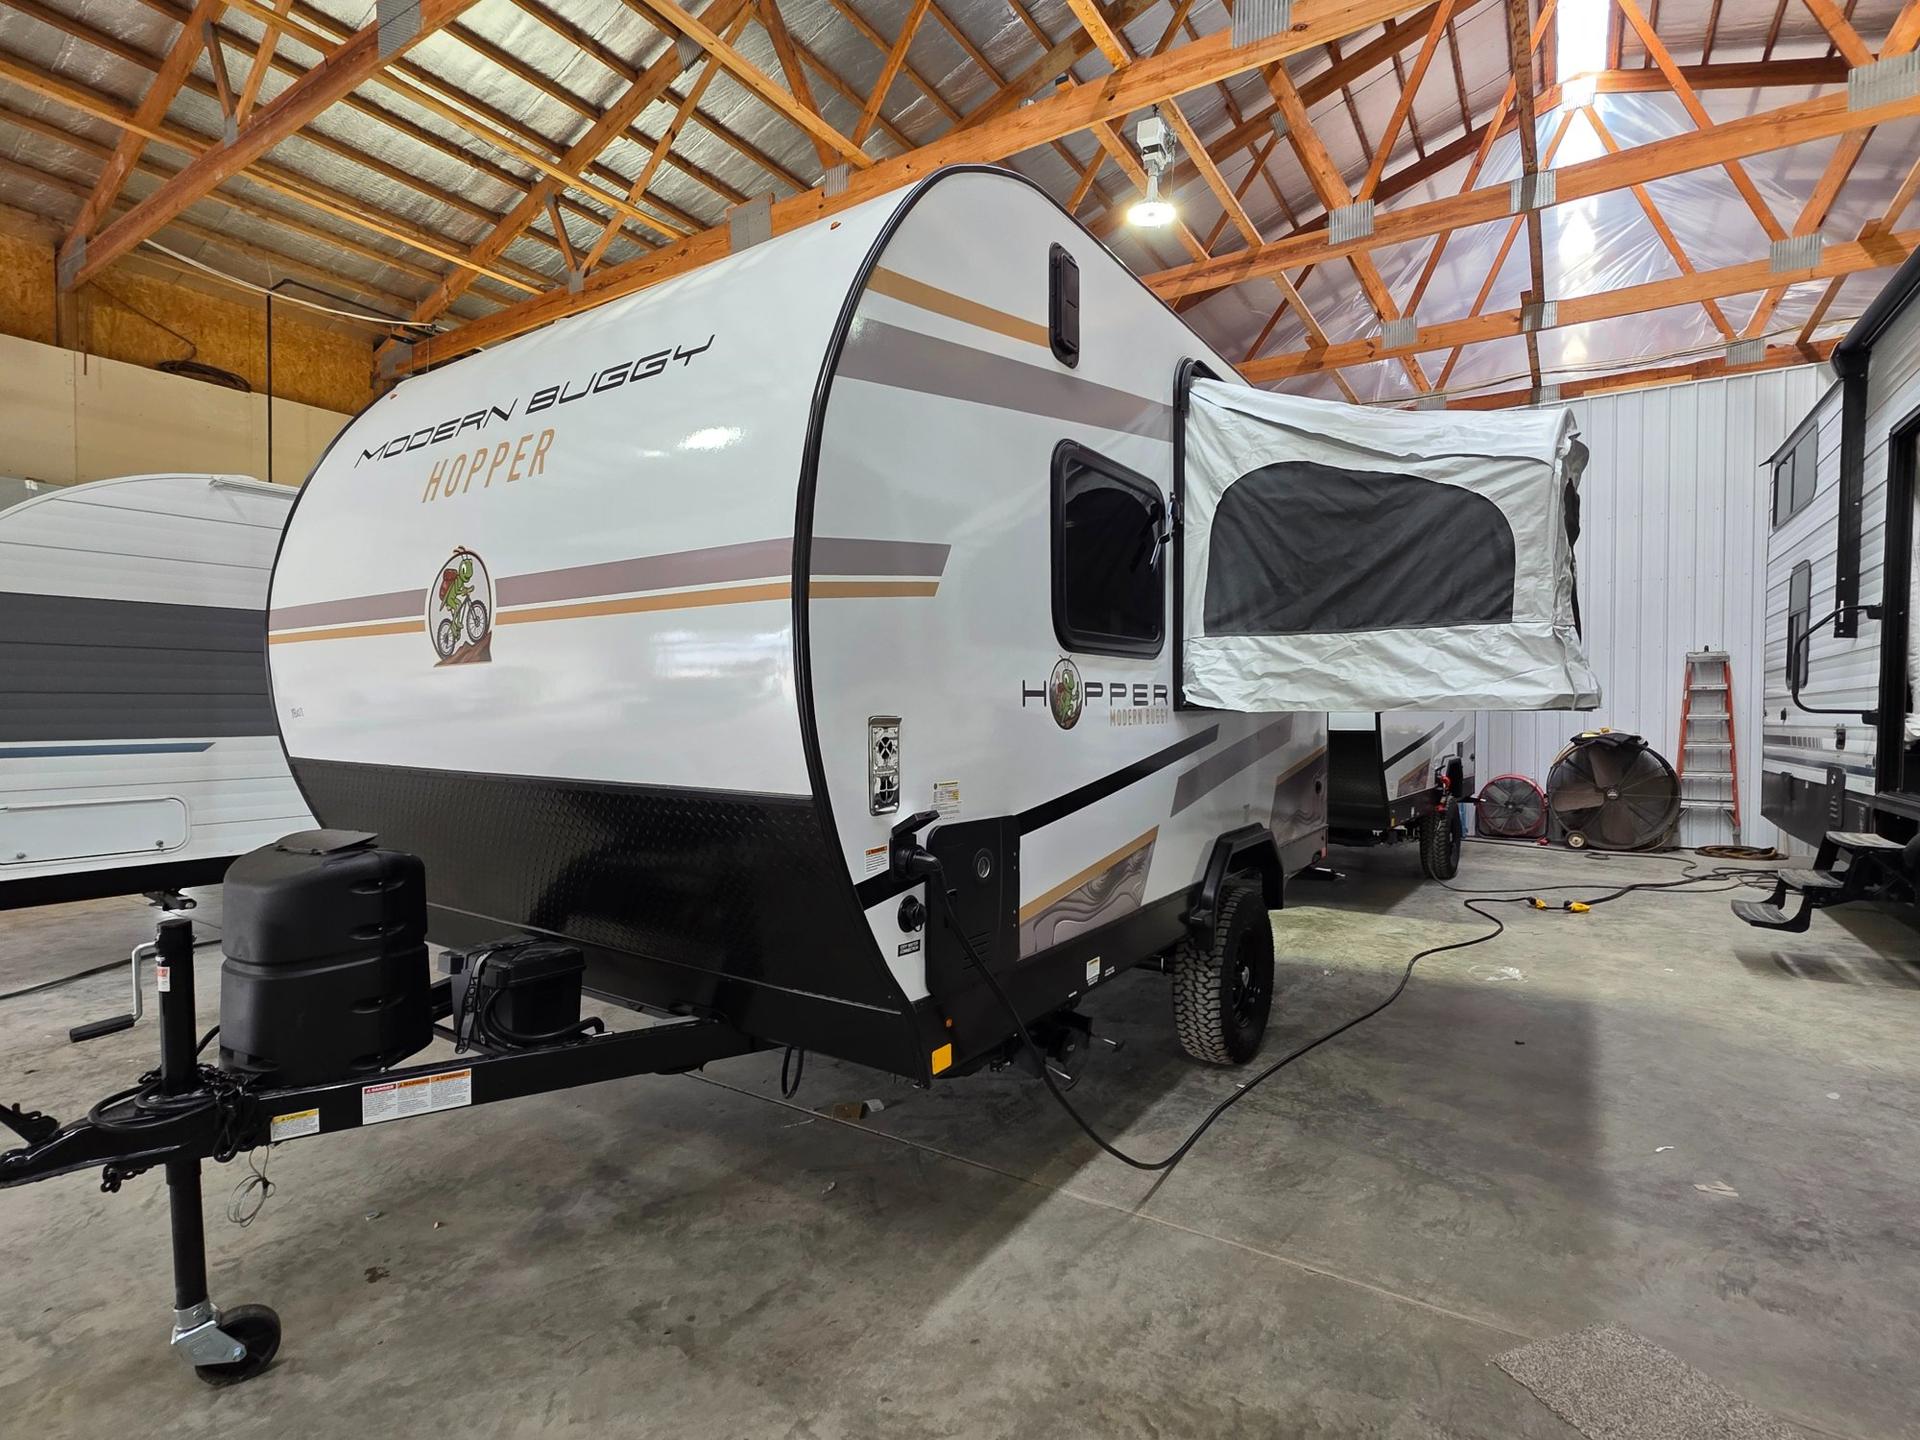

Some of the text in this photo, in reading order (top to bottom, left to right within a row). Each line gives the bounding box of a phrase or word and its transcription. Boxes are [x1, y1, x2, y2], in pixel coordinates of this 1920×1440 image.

[354, 334, 715, 469] MODERN BUGGY
[422, 428, 555, 503] HOPPER
[1109, 708, 1168, 726] MODERN BUGGY
